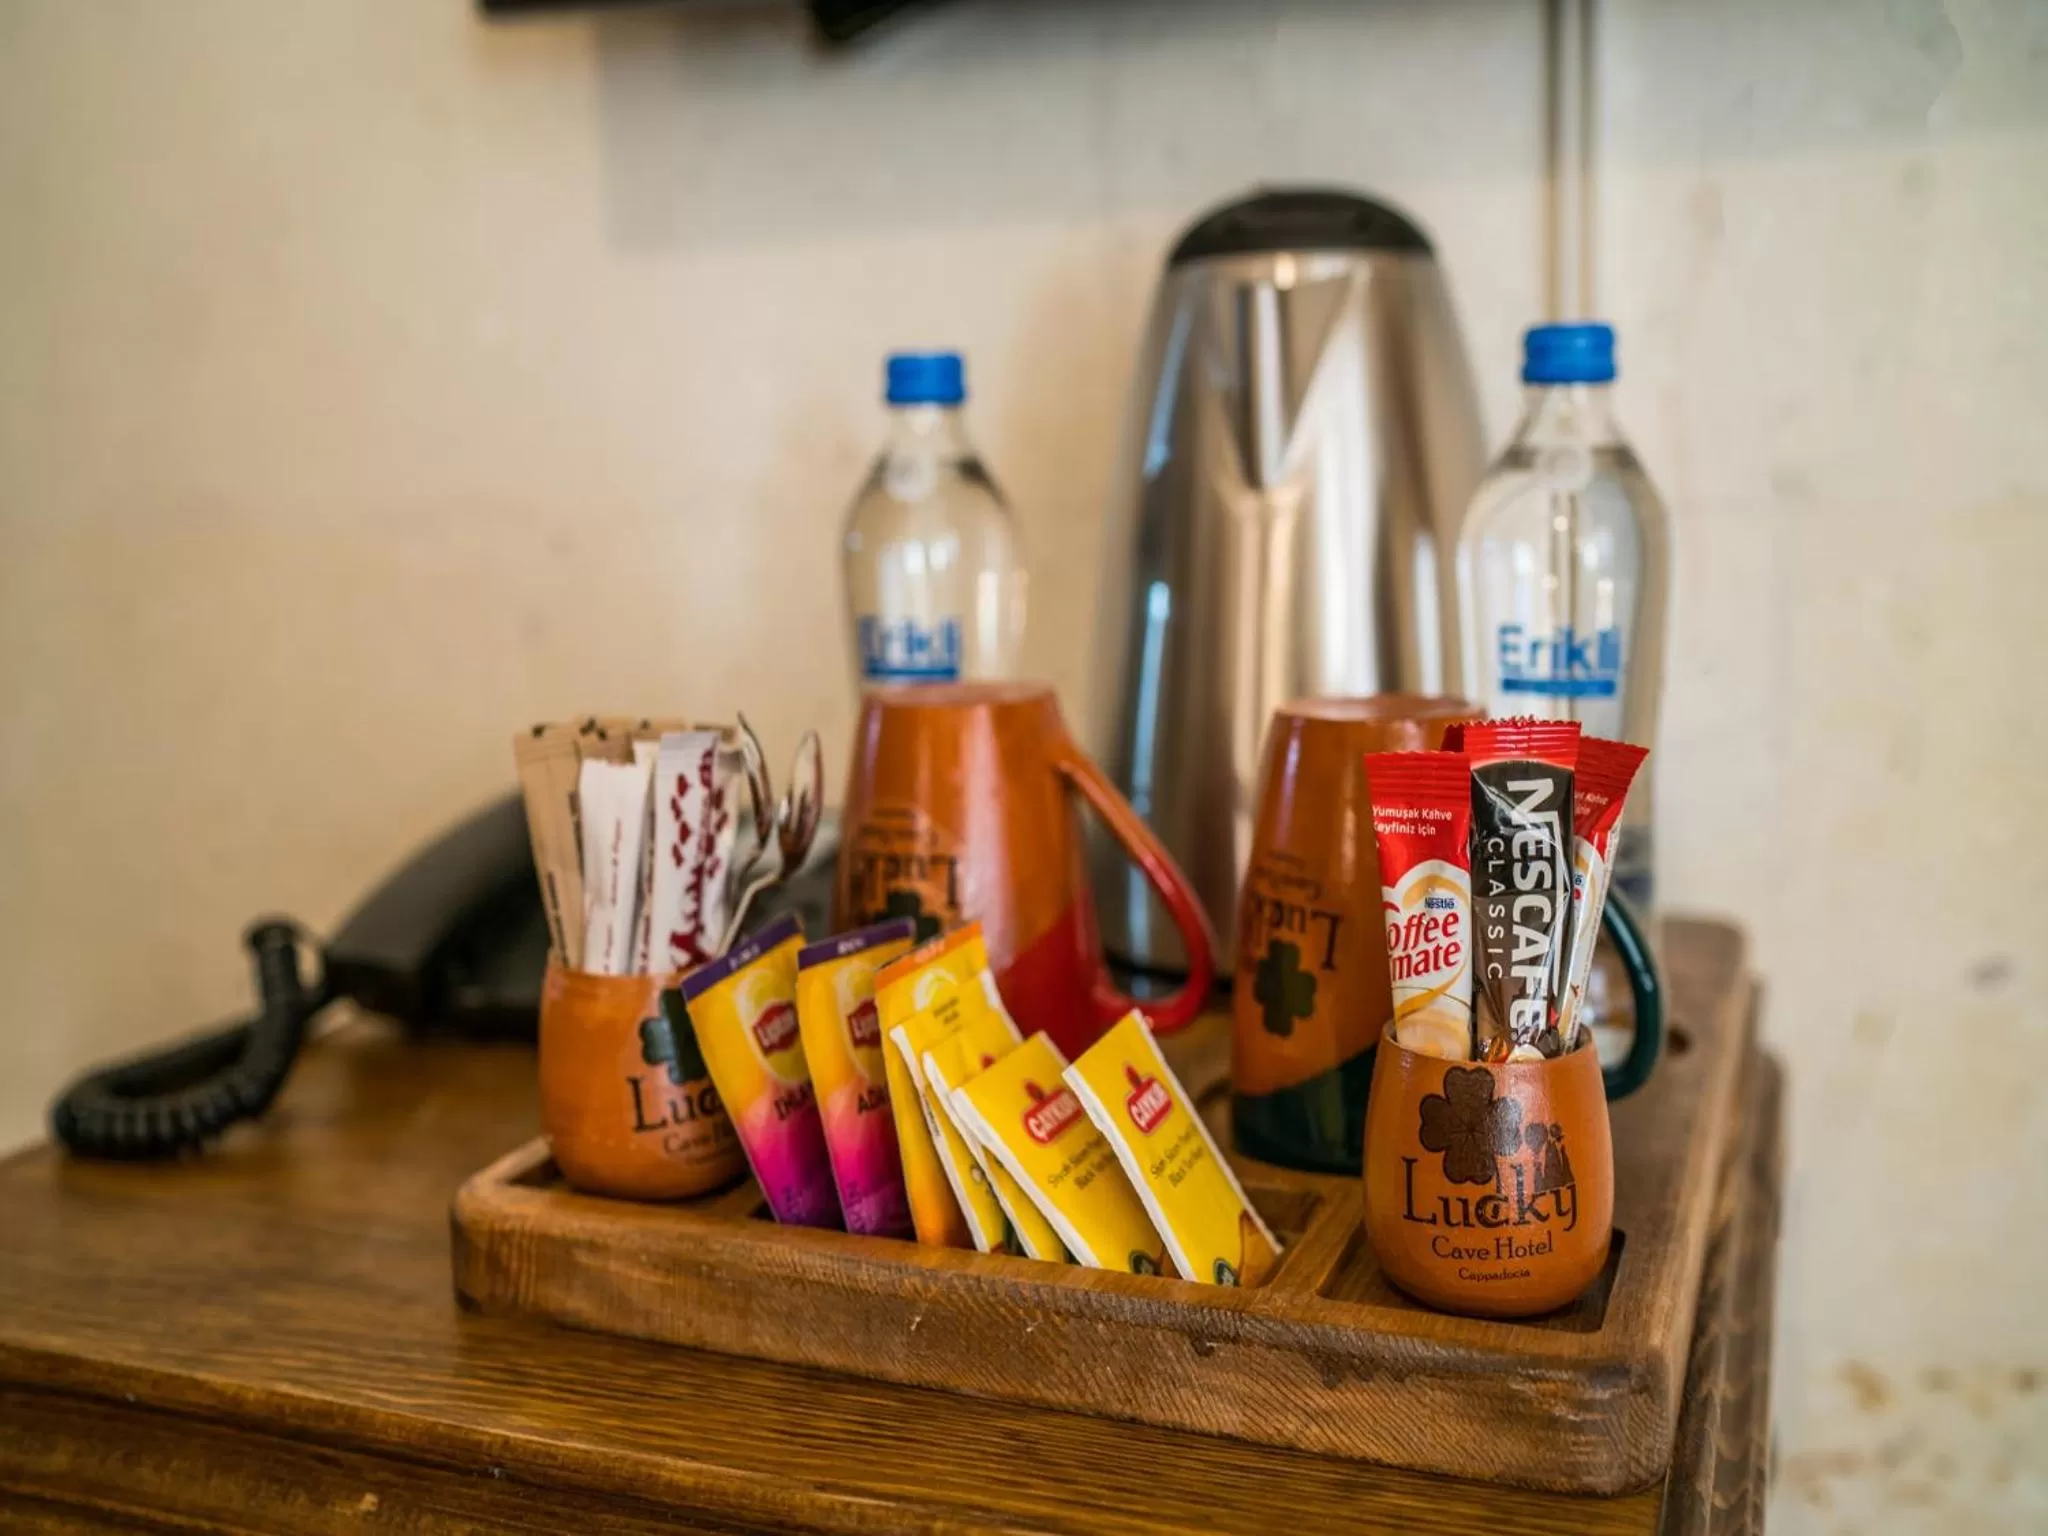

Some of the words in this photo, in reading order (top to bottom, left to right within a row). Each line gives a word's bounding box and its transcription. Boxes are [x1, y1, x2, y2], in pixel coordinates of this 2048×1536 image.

[1372, 805, 1420, 820] Yumuşak
[1422, 808, 1452, 821] Kahve
[1381, 900, 1460, 952] offee
[1485, 837, 1504, 980] CLASSIC
[626, 1074, 726, 1133] Luc
[1401, 1156, 1577, 1232] Lucky
[1431, 1235, 1491, 1261] Cave
[1495, 1231, 1554, 1261] Hotel
[1457, 1267, 1531, 1284] Cappadocia
